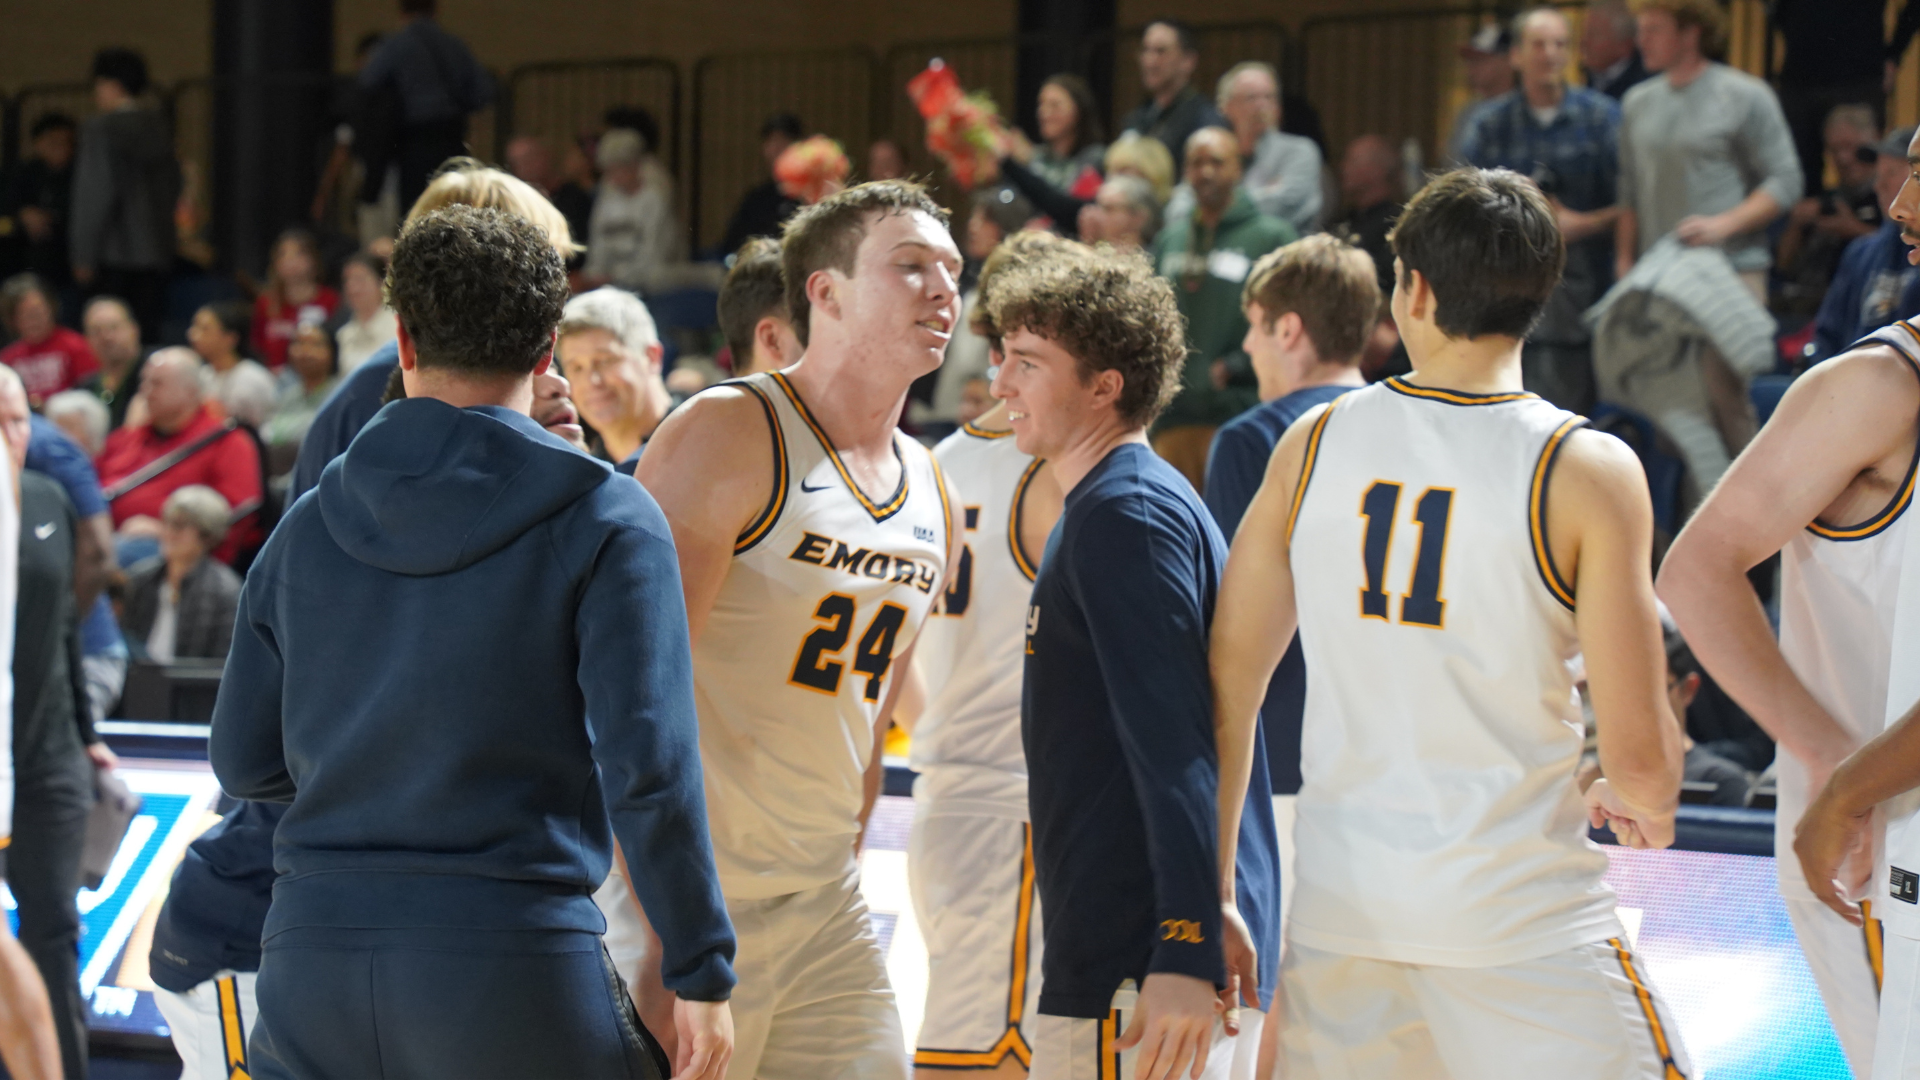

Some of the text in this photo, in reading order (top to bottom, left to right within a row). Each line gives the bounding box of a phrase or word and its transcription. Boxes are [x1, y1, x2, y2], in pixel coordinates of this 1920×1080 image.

[787, 530, 936, 595] EMORY
[1359, 478, 1455, 630] 11
[786, 590, 909, 705] 24
